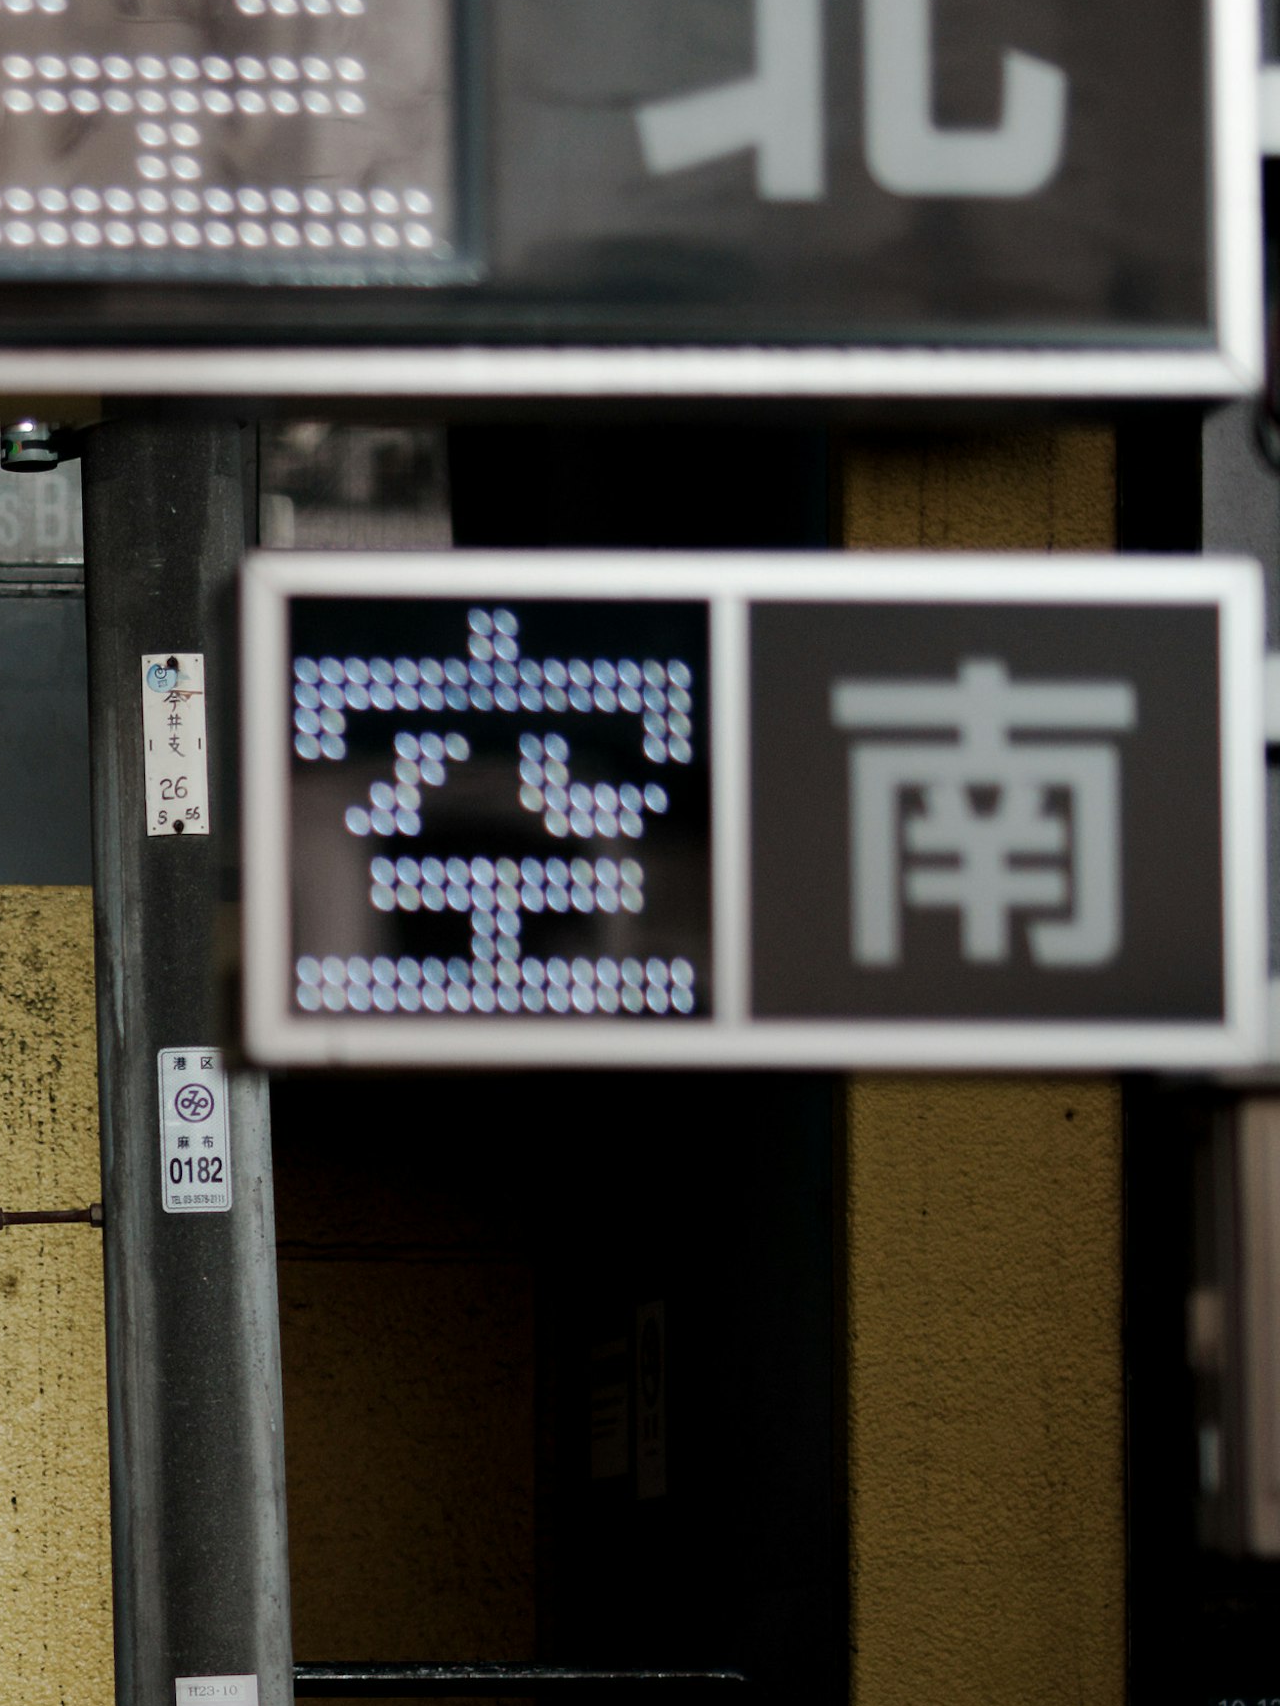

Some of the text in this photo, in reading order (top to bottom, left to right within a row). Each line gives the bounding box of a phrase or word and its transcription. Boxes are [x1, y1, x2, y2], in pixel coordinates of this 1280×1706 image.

[160, 776, 188, 801] 26
[294, 608, 696, 1014] 空
[831, 656, 1138, 969] 南
[173, 1056, 214, 1071] 港区
[177, 1135, 214, 1149] 麻布
[169, 1156, 223, 1184] 0182
